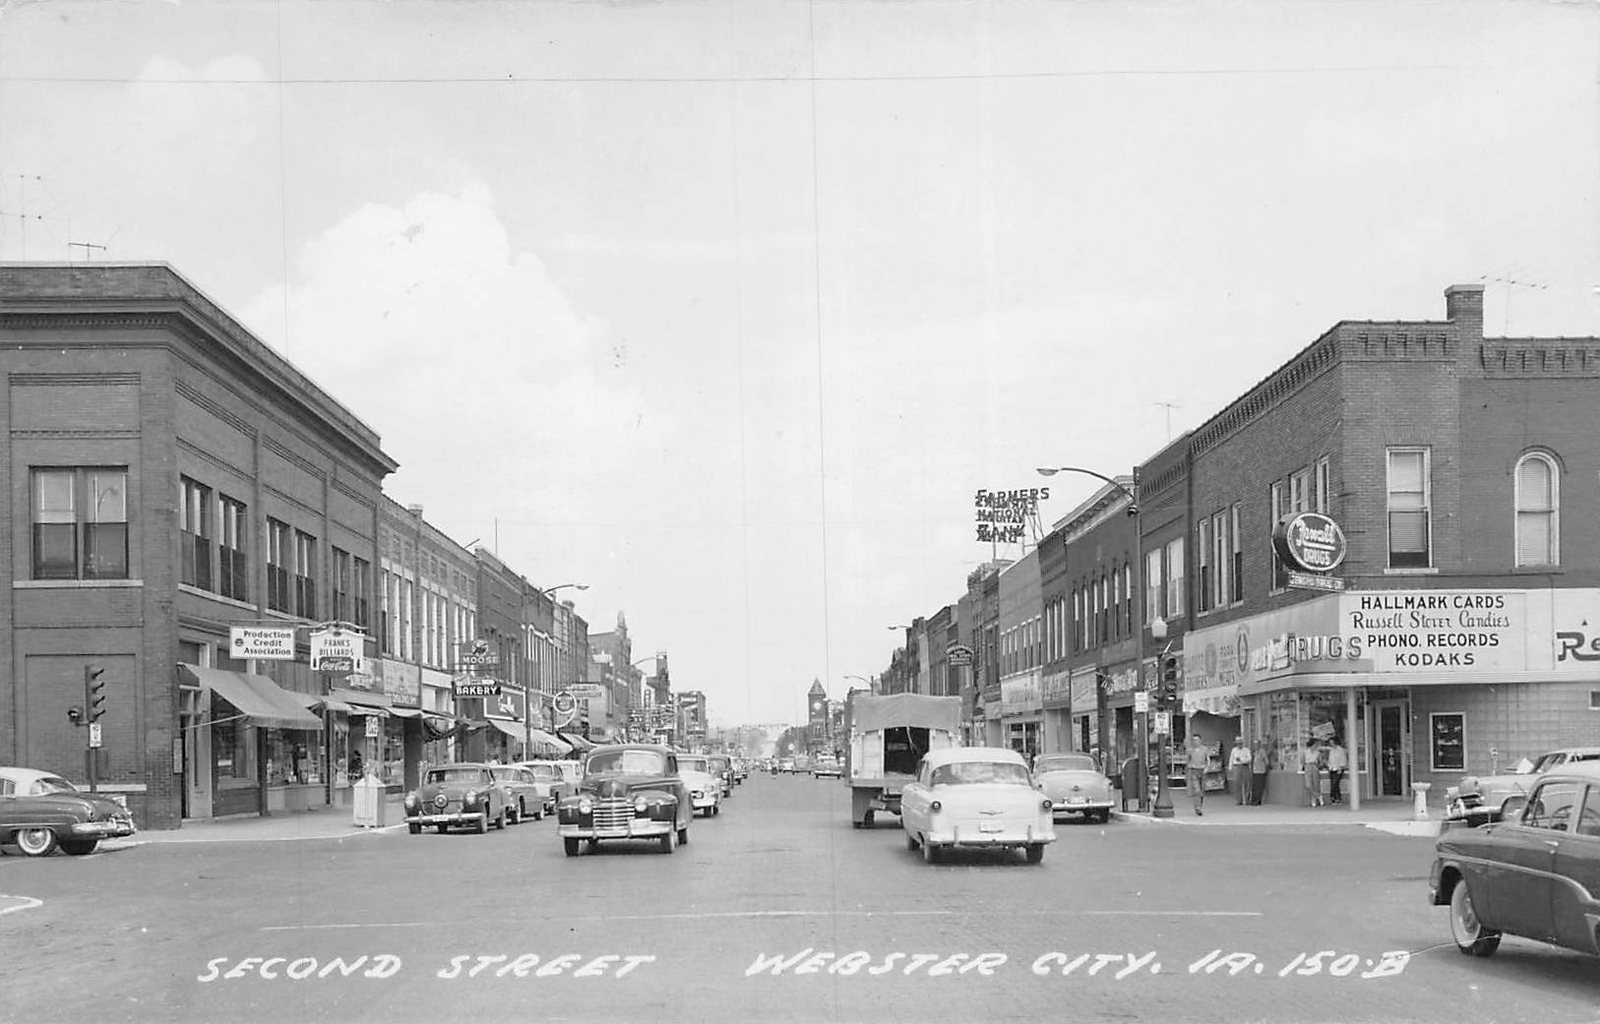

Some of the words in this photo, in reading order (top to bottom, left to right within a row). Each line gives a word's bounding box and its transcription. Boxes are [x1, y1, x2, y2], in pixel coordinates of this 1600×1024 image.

[976, 487, 1050, 504] FARMERS
[1303, 548, 1331, 565] DRUGS
[1361, 595, 1448, 610] HALLMARK
[1453, 595, 1505, 609] CARDS
[1349, 611, 1403, 629] Russell
[1409, 610, 1452, 629] Stover
[1459, 609, 1510, 628] Candies
[243, 630, 292, 638] Production
[1367, 633, 1422, 648] PHONO.
[1427, 633, 1499, 647] RECORDS
[253, 639, 282, 647] Credit
[1287, 635, 1362, 661] DRUGS
[243, 647, 292, 655] Association
[463, 656, 498, 664] MOOSE
[1395, 652, 1475, 667] KODAKS
[456, 686, 498, 695] BAKERY
